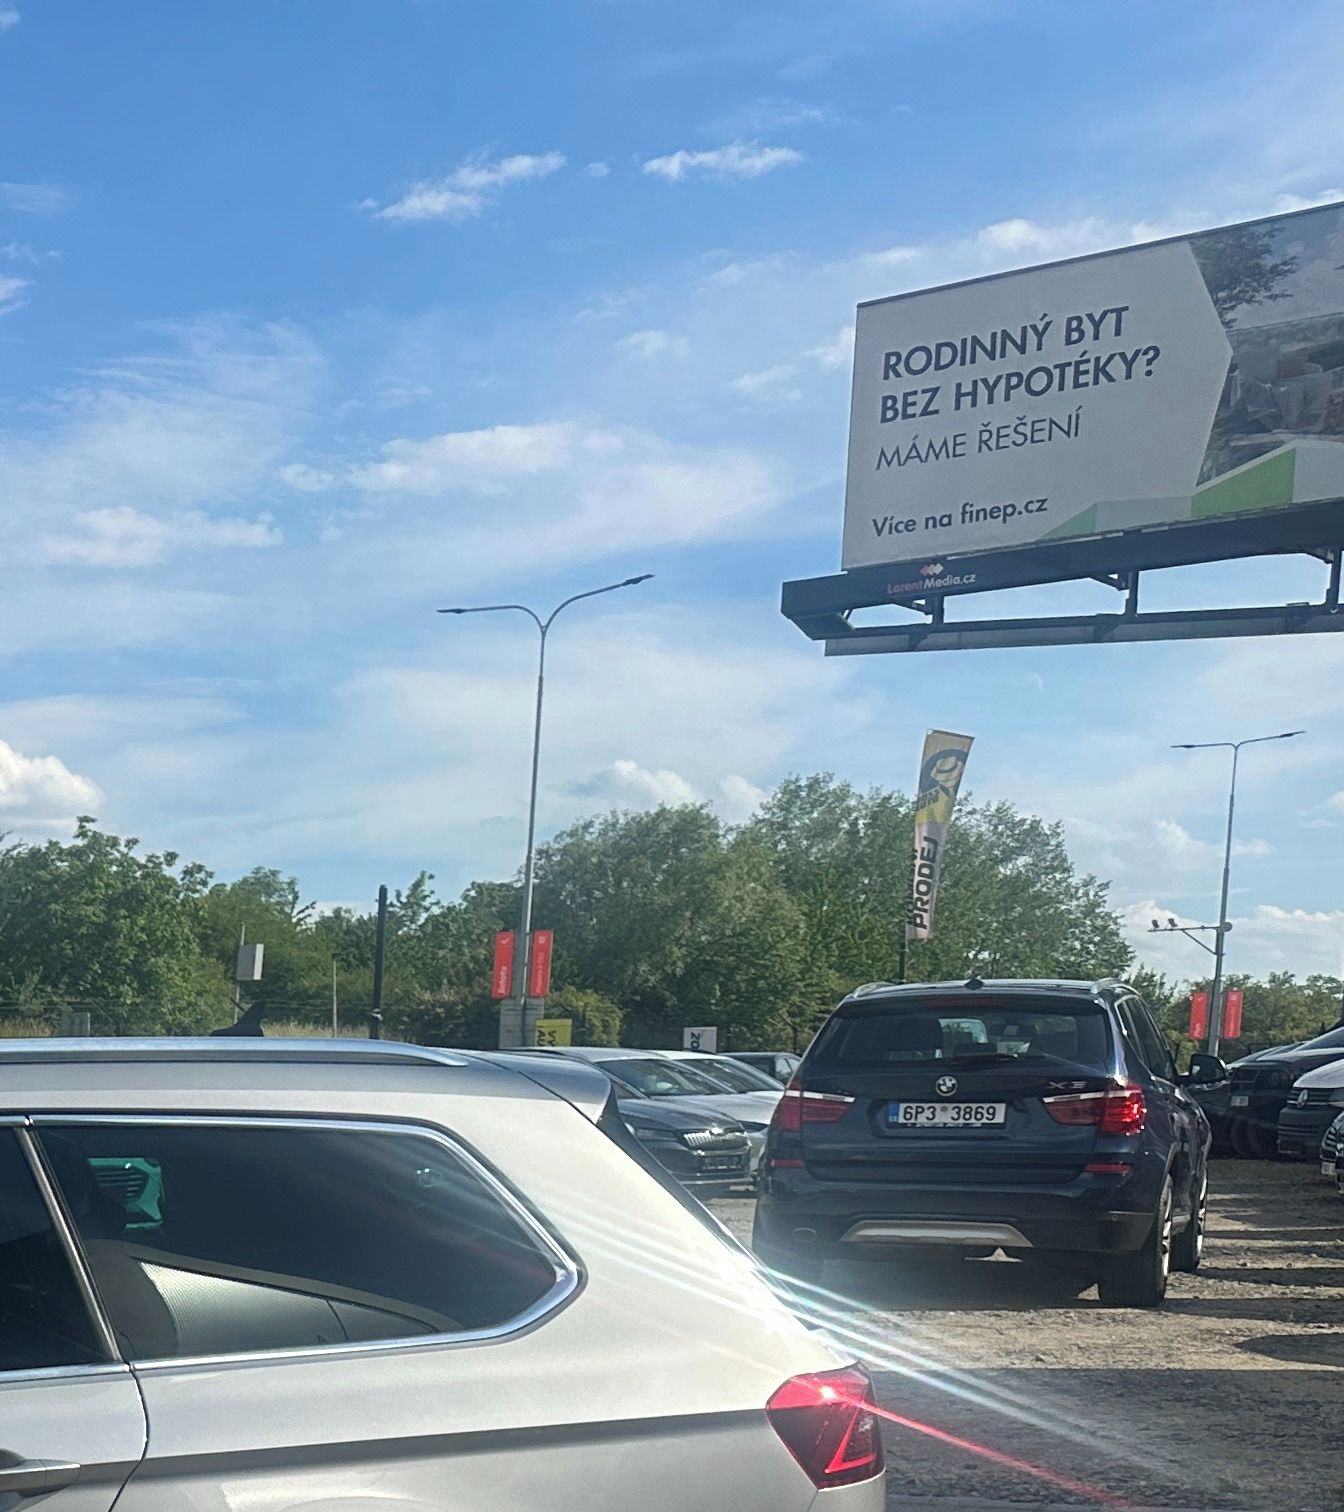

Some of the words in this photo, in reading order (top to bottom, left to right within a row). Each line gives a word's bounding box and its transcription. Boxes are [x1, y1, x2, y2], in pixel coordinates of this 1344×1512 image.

[882, 312, 1053, 381] RODINNÝ
[1064, 306, 1129, 346] BYT
[880, 386, 941, 424] BEZ
[954, 345, 1160, 411] HYPOTÉKY?
[875, 434, 967, 471] MÁME
[977, 405, 1083, 453] ŘEŠENÍ
[872, 516, 916, 537] Více
[924, 512, 952, 530] na
[961, 498, 1048, 525] finep.cz
[913, 836, 939, 930] PRODEJ
[902, 1105, 937, 1122] 6P3
[950, 1105, 997, 1122] 3869
